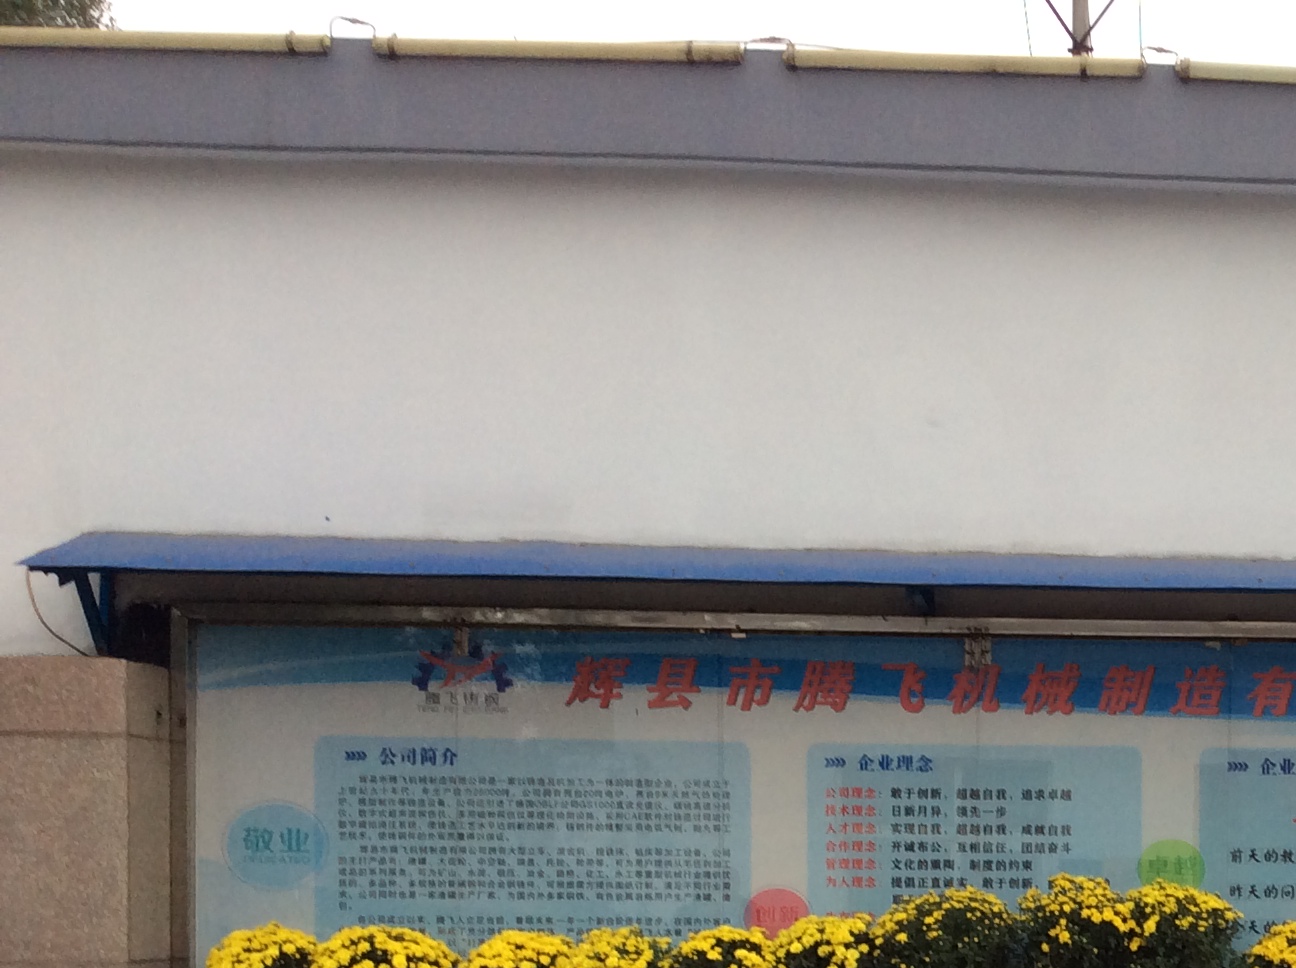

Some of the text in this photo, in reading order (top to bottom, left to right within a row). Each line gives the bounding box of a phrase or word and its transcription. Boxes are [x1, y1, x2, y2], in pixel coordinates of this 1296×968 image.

[379, 747, 458, 766] 公司简介
[857, 754, 934, 773] 企业理念
[242, 826, 310, 854] 敬业
